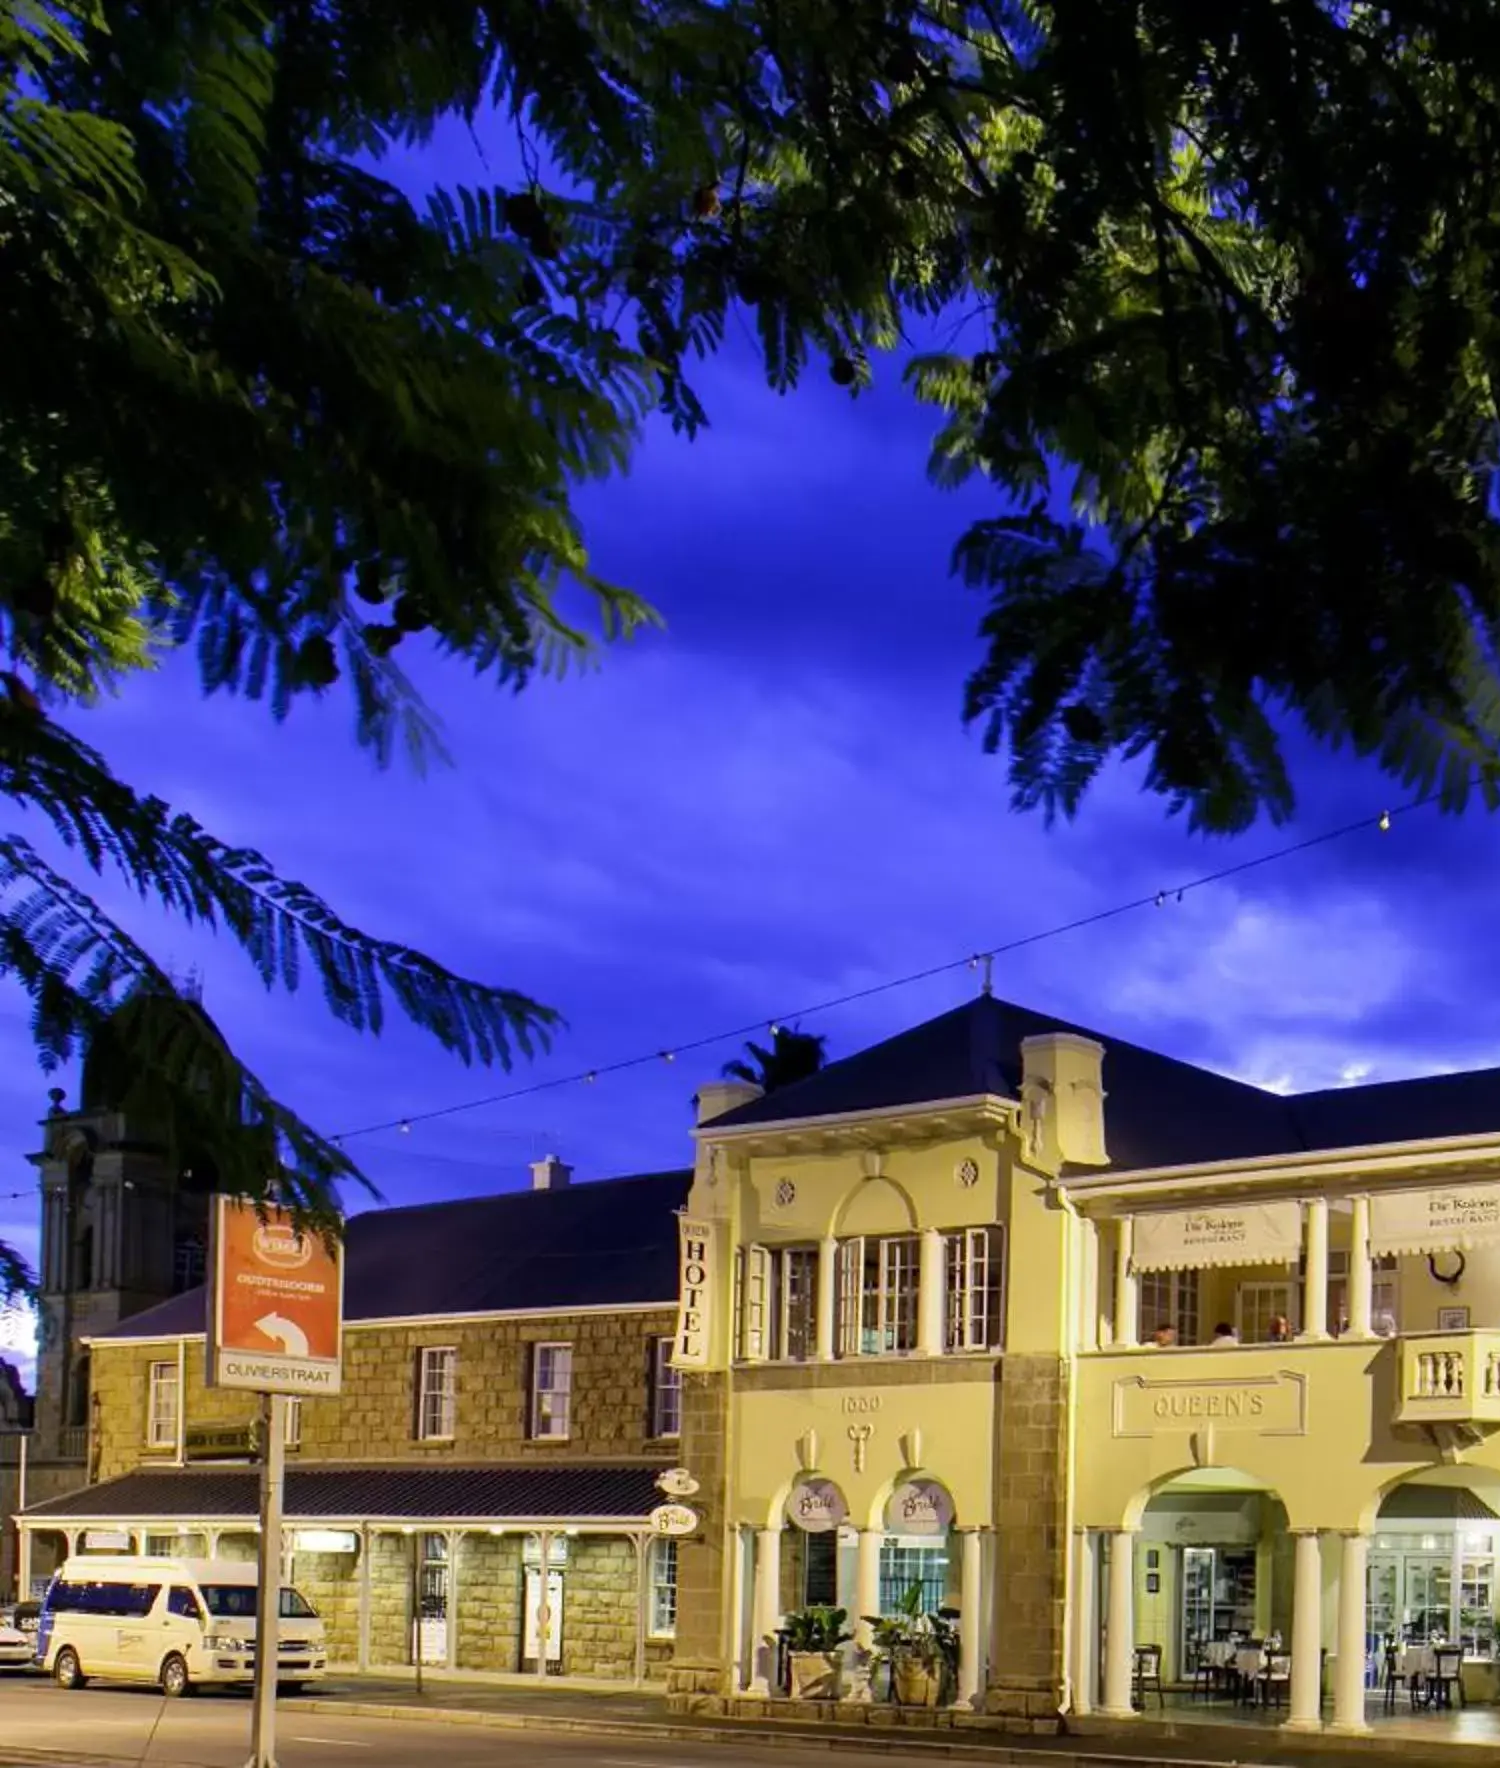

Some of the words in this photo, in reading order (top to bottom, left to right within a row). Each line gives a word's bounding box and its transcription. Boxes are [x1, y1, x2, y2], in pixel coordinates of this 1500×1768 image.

[1428, 1213, 1500, 1227] RESTAURANT
[682, 1239, 706, 1357] HOTEL
[226, 1362, 331, 1384] OLIVIERSTRAAT
[1153, 1390, 1264, 1418] QUEEN'S
